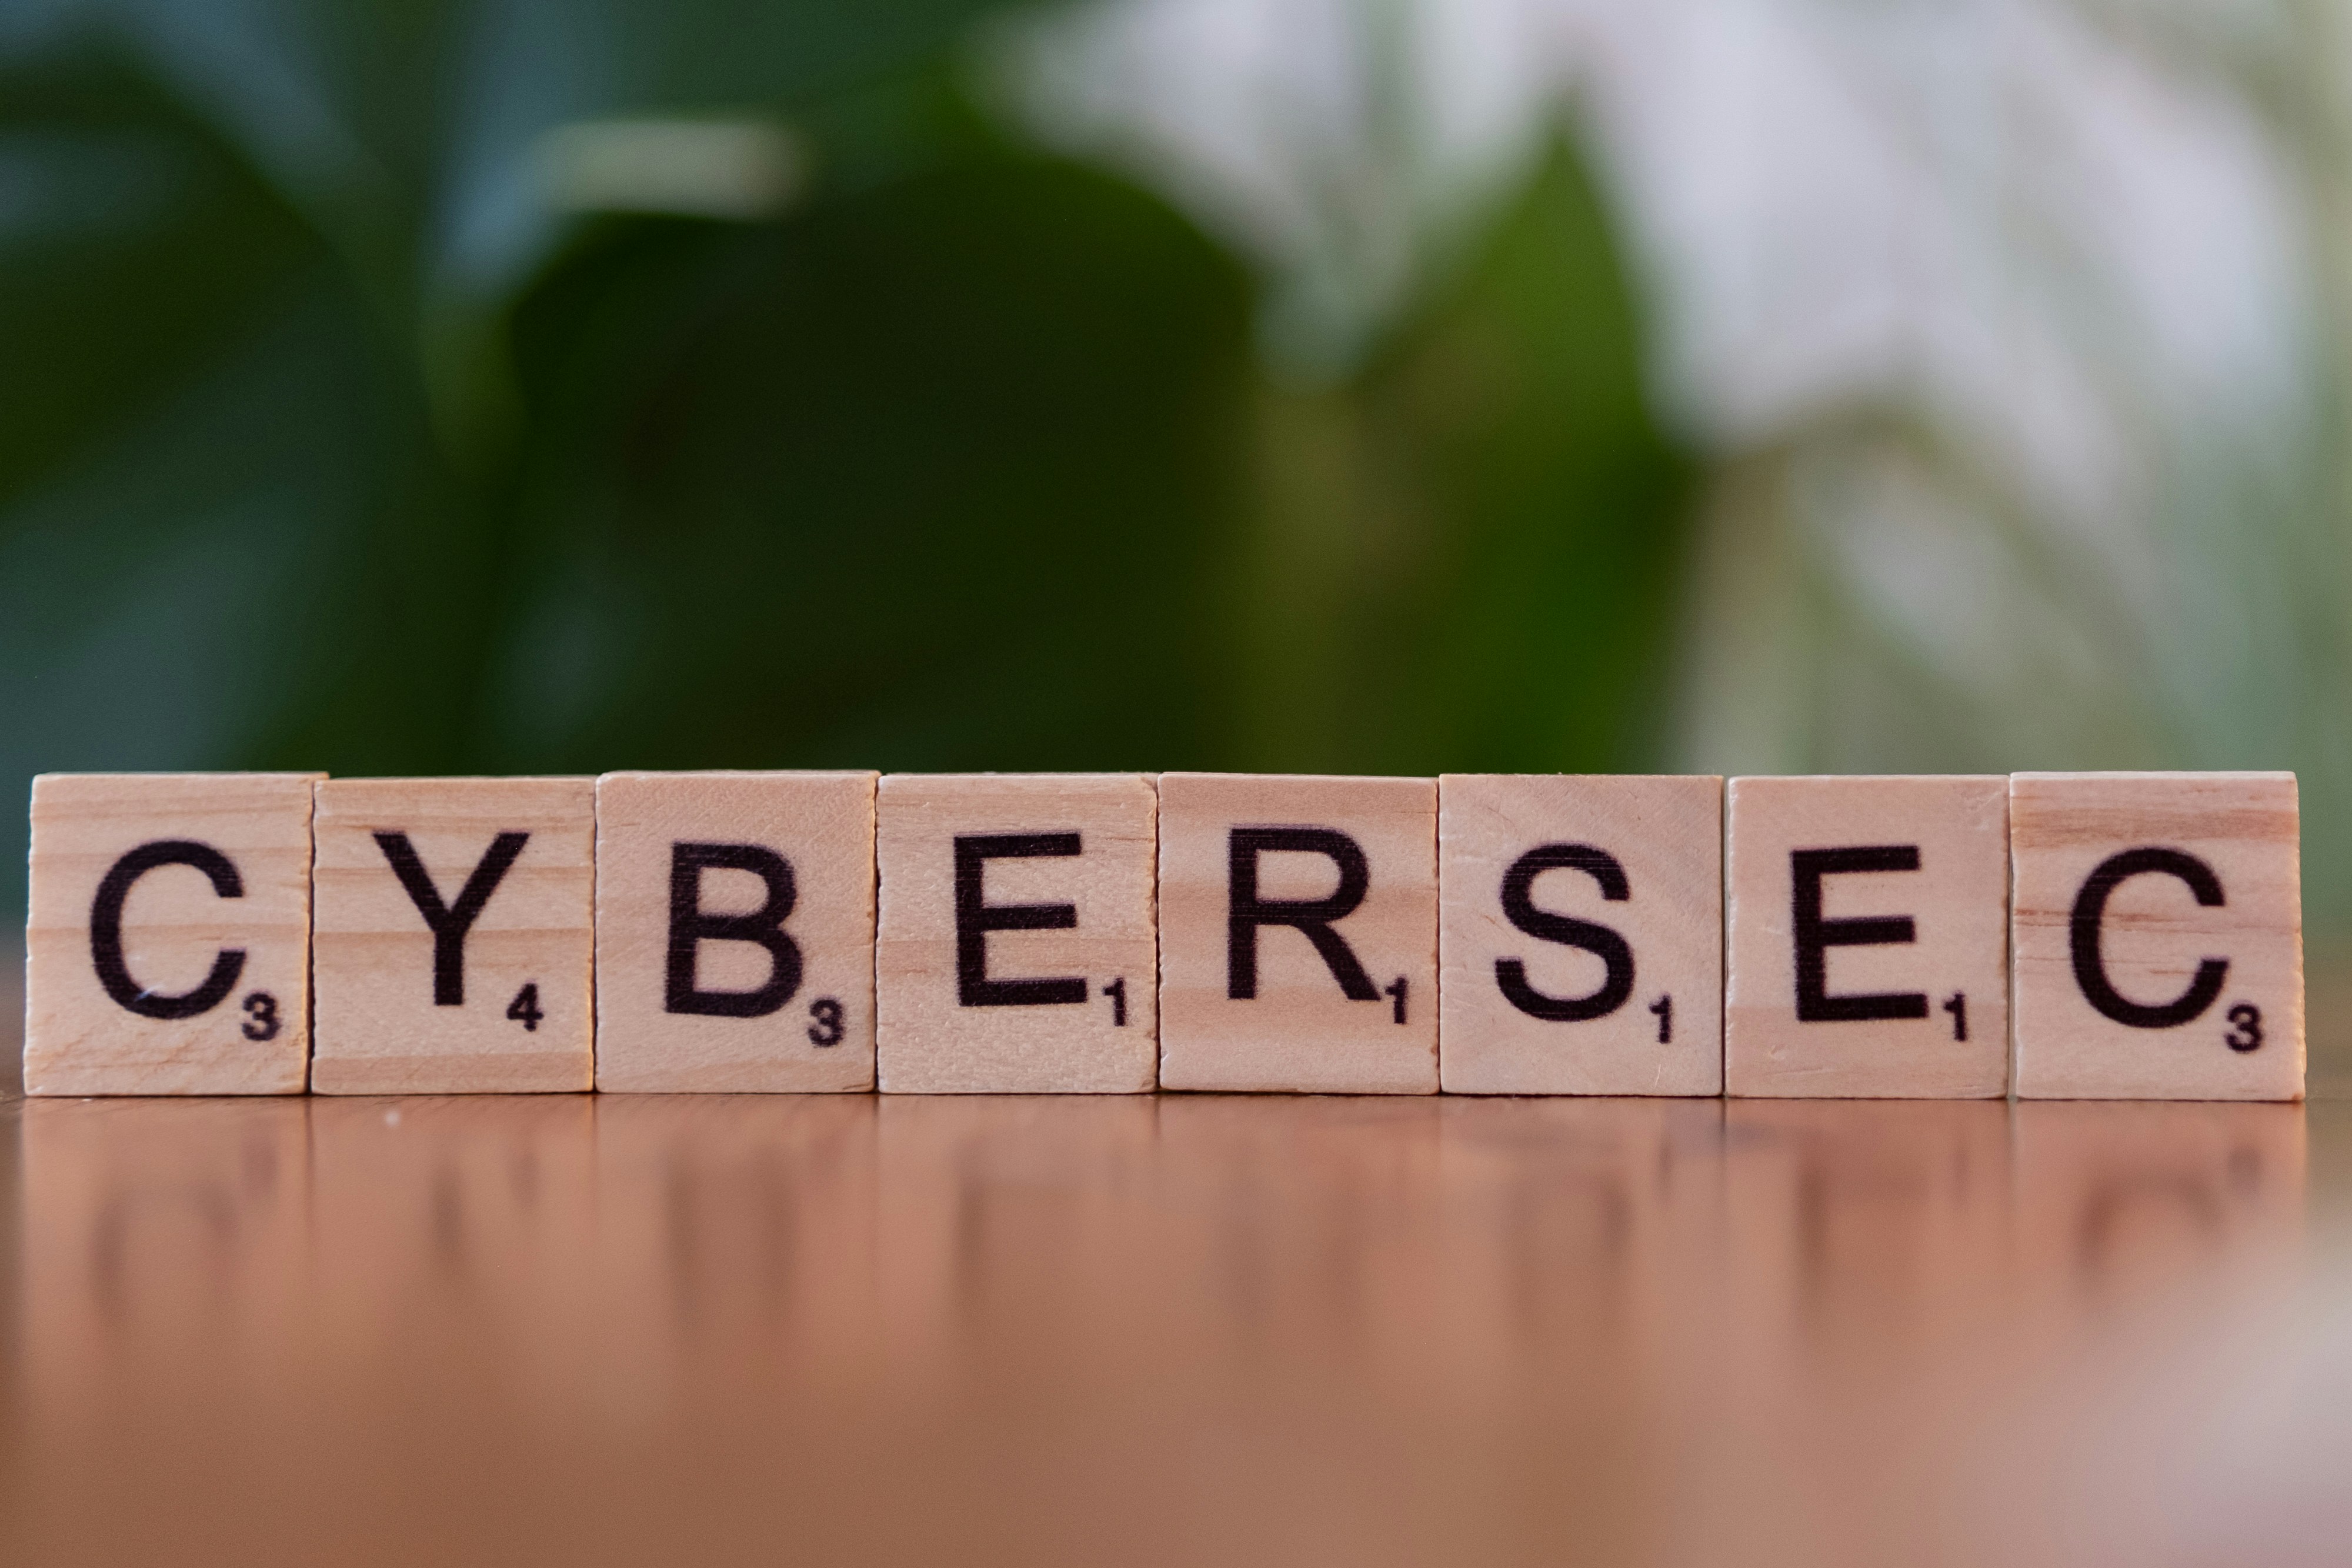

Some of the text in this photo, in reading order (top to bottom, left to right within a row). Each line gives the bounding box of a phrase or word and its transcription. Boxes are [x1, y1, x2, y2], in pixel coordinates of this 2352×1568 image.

[242, 992, 281, 1042] 3
[506, 983, 544, 1032] 4
[807, 997, 846, 1047] 3
[1102, 977, 1129, 1027] 1
[1383, 976, 1410, 1025] 1
[1649, 995, 1673, 1044] 1
[1942, 992, 1969, 1042] 1
[2224, 1003, 2265, 1053] 3
